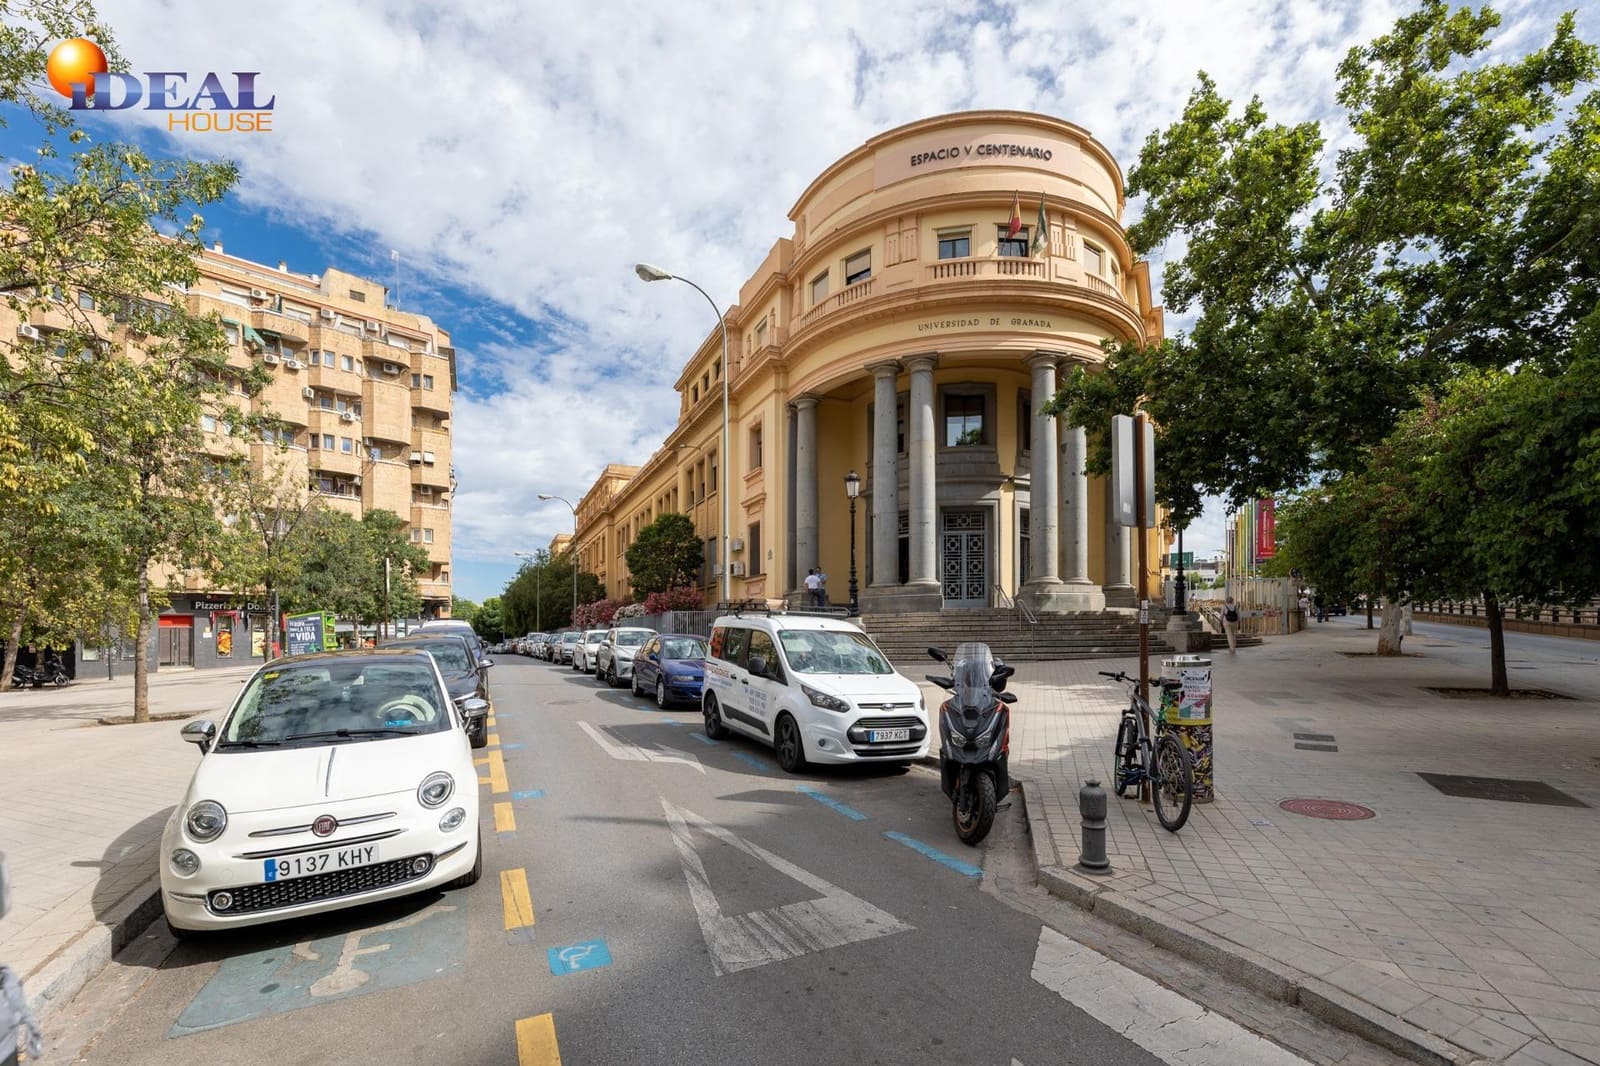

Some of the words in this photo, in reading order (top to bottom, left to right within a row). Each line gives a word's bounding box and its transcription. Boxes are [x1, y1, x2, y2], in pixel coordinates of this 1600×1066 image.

[911, 147, 960, 166] ESPACIO
[964, 146, 972, 156] V
[977, 144, 1053, 161] CENTENARIO
[918, 318, 980, 331] UNIVERSIDAD
[990, 318, 1000, 326] DE
[1011, 318, 1052, 329] GRANADA
[296, 632, 315, 641] VIDA
[876, 731, 893, 740] 7937
[319, 821, 331, 832] FIAT
[279, 854, 330, 876] 9137
[338, 846, 374, 868] KHY
